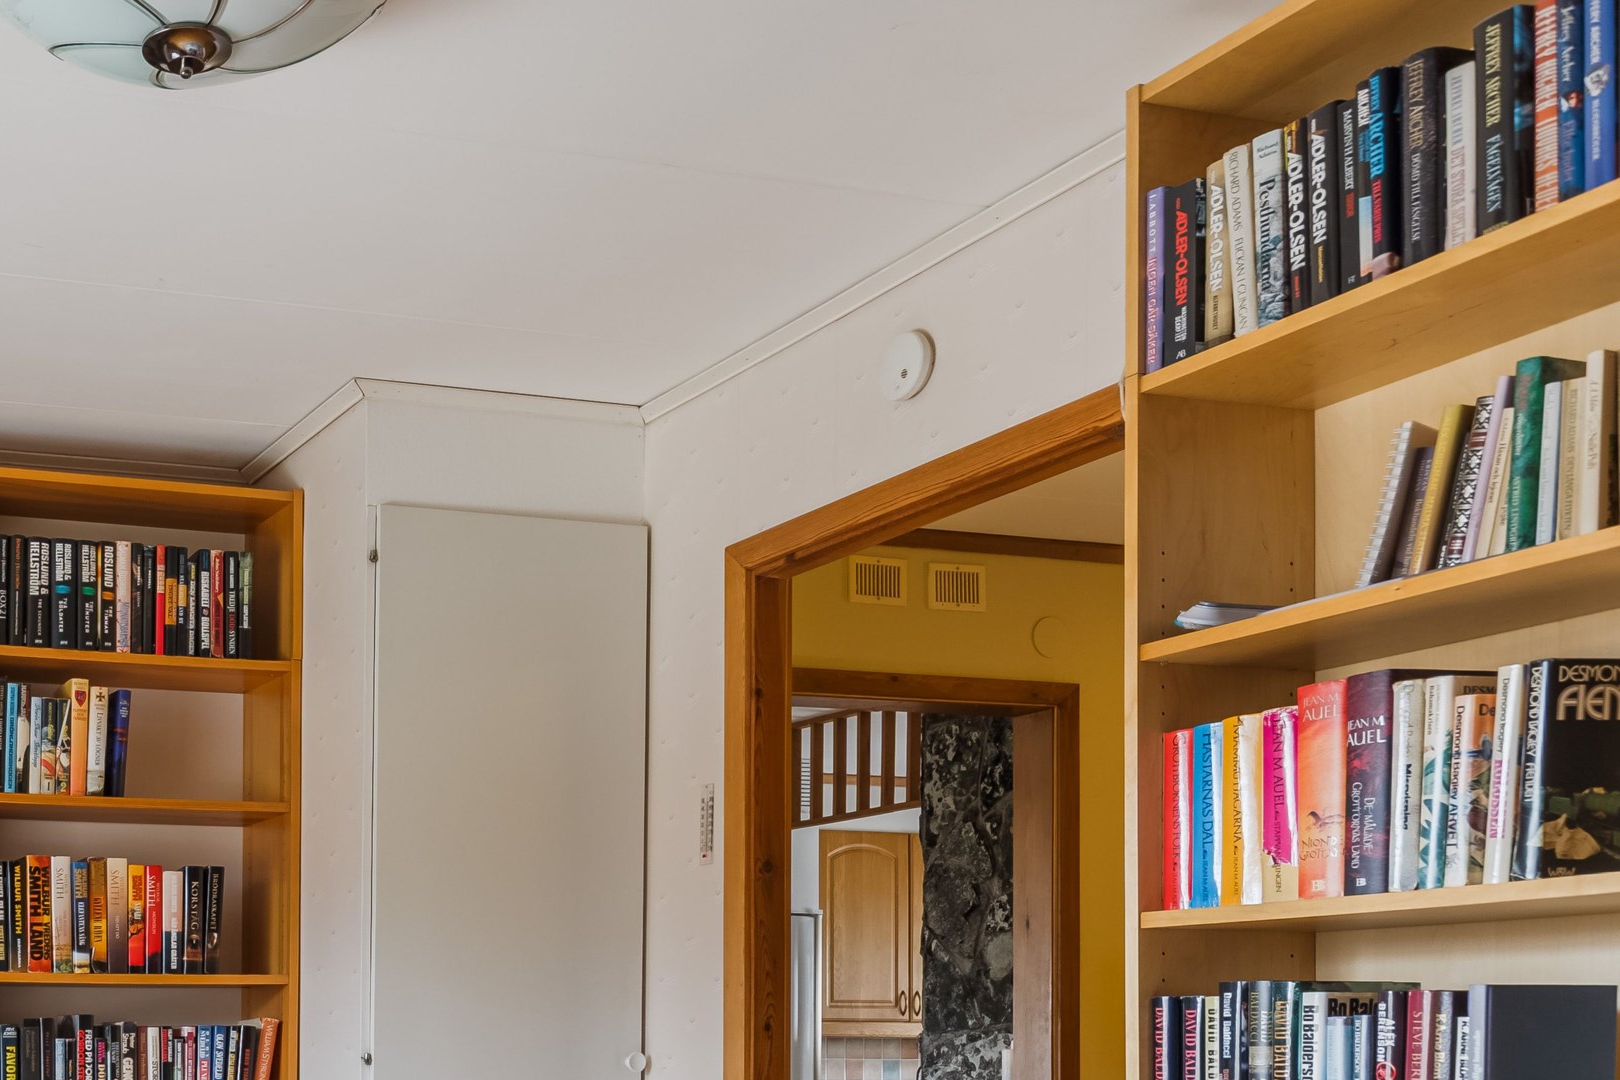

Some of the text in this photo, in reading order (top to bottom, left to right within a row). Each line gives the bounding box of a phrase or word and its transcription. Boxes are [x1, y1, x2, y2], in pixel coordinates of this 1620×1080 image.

[1408, 61, 1427, 151] JEFFREY ARCHER
[1369, 111, 1386, 179] ARCHER
[1228, 151, 1241, 194] RICHARD
[1310, 134, 1328, 245] ADLER-OLSEN
[1232, 197, 1243, 232] ADAMS
[1257, 176, 1278, 293] Pesthundarna
[1286, 153, 1306, 272] ADLER-OLSEN
[1174, 211, 1189, 306] ADLER-OLSEN
[1209, 185, 1225, 292] ADLER-OLSEN
[29, 541, 43, 596] HELLSTRÖM
[40, 542, 50, 595] ROSLUND &
[55, 542, 66, 582] HELLSTRÖM
[104, 545, 114, 588] ROSLUND
[1301, 706, 1341, 723] AUEL
[1499, 678, 1511, 722] Desmond
[1528, 666, 1543, 719] DESMOND
[1346, 728, 1387, 747] AUEL
[1272, 756, 1285, 813] M AUEL
[1200, 820, 1214, 848] DAL
[14, 864, 22, 935] WILBUR SMITH
[41, 865, 51, 916] WILBUR
[55, 867, 65, 900] SMITH
[147, 874, 156, 908] SMITH
[190, 880, 201, 931] KORSTÅG
[29, 865, 43, 961] SMITH LAND
[1154, 1007, 1165, 1043] DAVID
[1184, 1009, 1197, 1047] DAVID
[1207, 1008, 1220, 1043] DAVID
[1223, 992, 1233, 1018] David
[1250, 991, 1260, 1043] BALDACCI
[1301, 1005, 1318, 1022] Bo
[1222, 1019, 1233, 1059] Baldacci
[1375, 1002, 1388, 1062] BERENSON
[1409, 1010, 1423, 1050] STEVE
